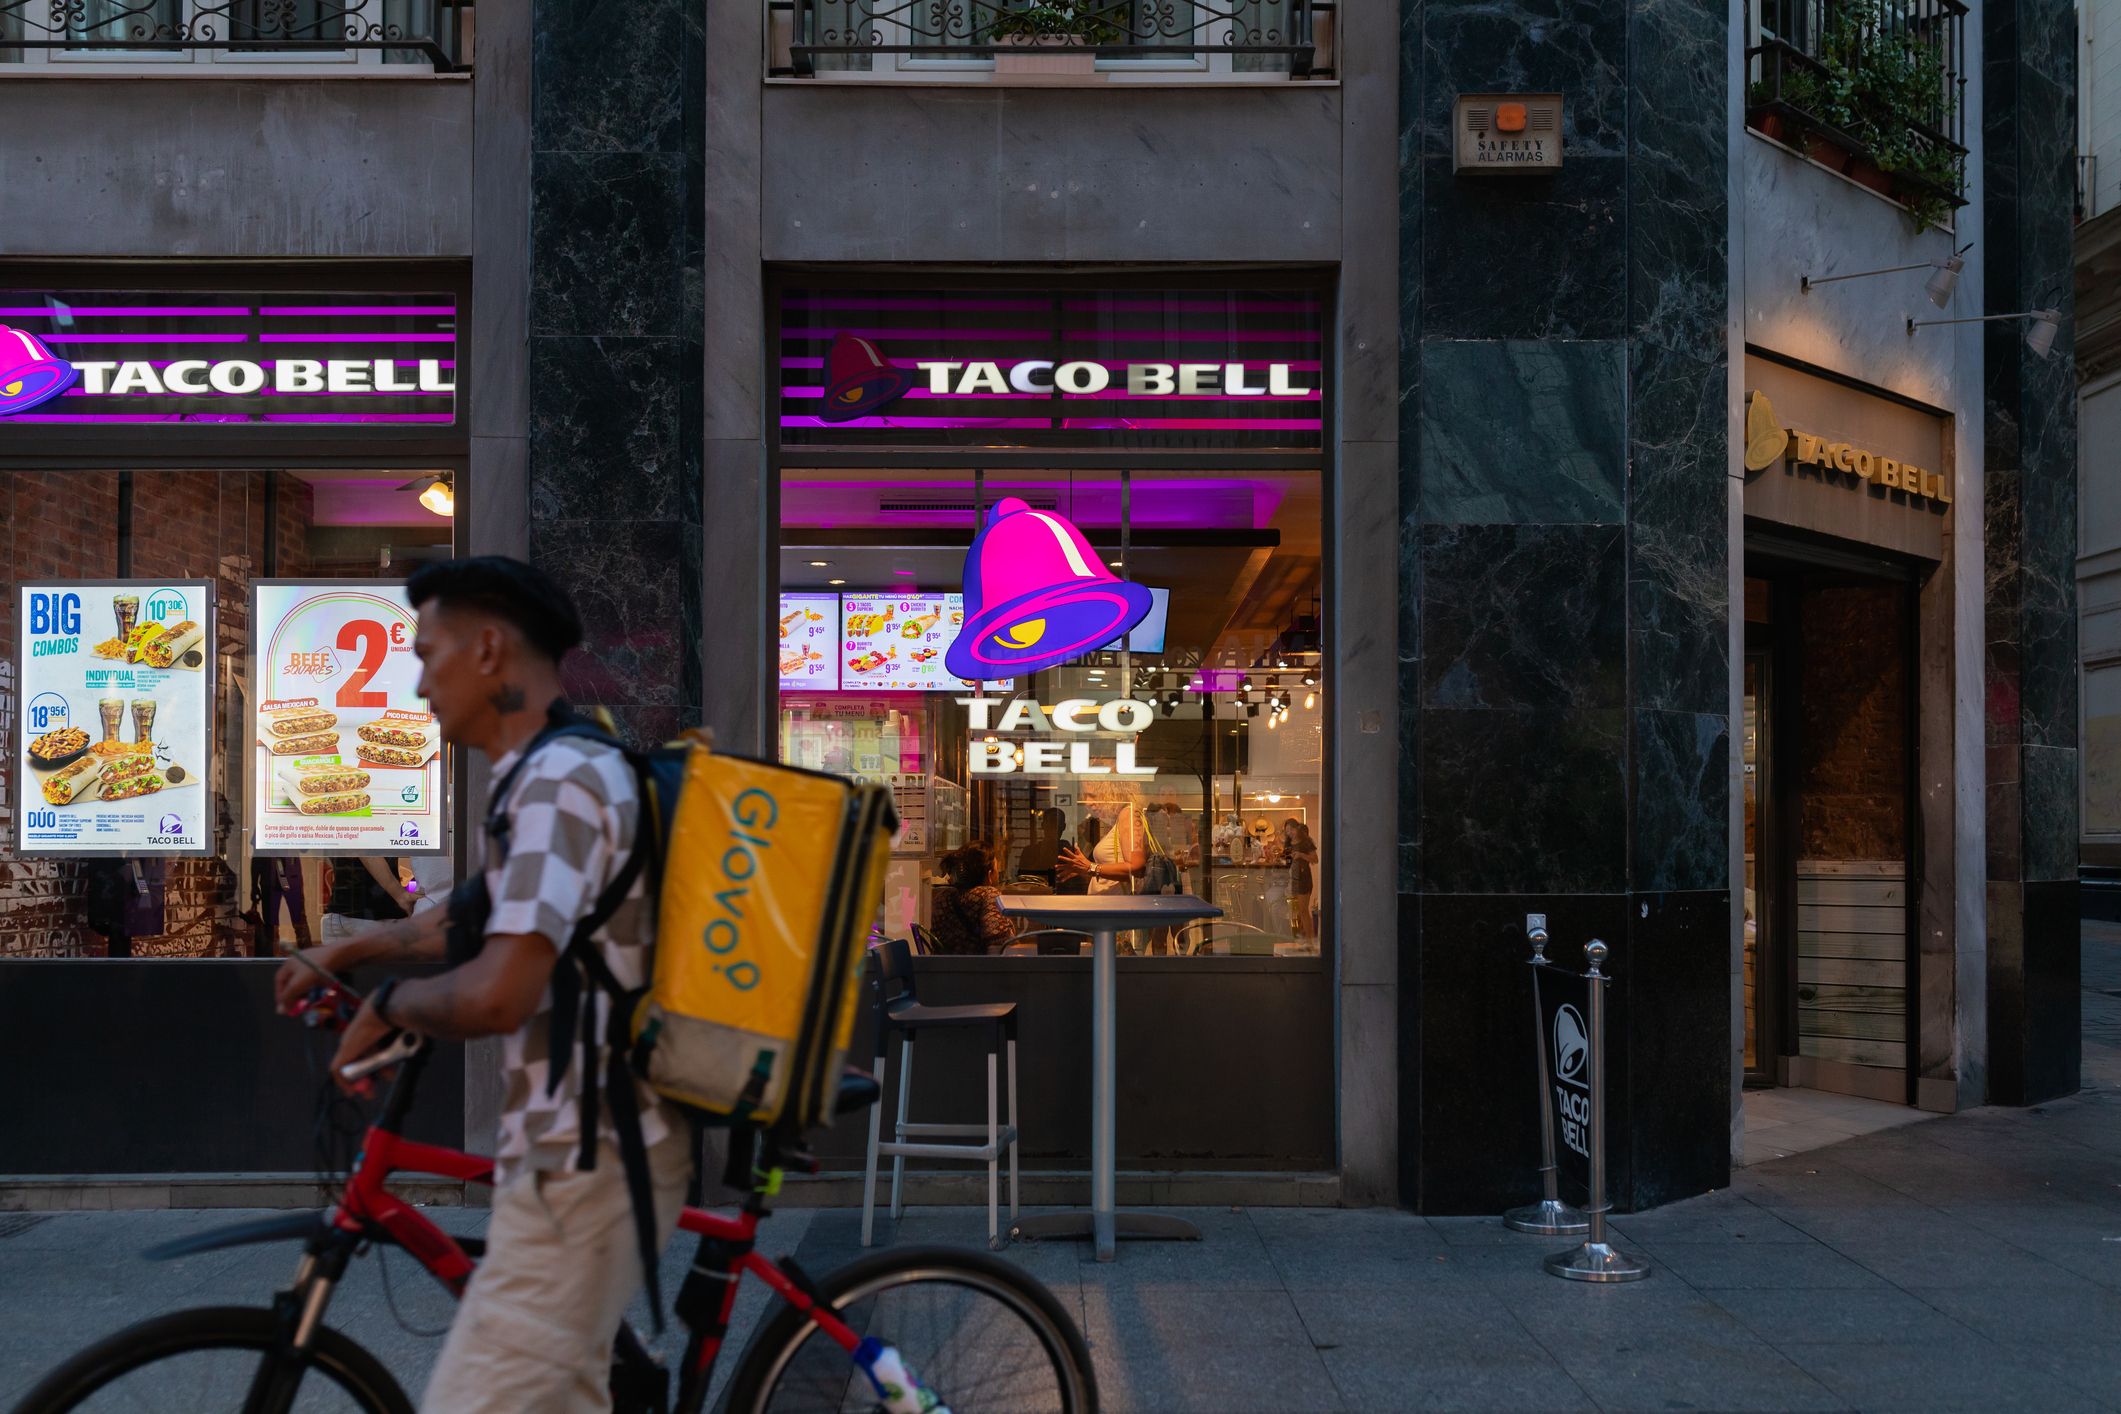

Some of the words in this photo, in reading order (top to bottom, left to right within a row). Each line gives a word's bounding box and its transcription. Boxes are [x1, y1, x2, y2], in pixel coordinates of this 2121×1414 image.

[1478, 140, 1543, 151] SAFETY
[1478, 151, 1543, 162] ALARMAS
[71, 359, 267, 394] TACO
[275, 358, 455, 393] BELL
[916, 359, 1109, 394] TACO
[1127, 362, 1311, 396] BELL
[1791, 429, 1875, 479] TACO
[1880, 456, 1953, 504] BELL
[30, 592, 81, 635] BIG
[390, 622, 406, 644] €
[32, 637, 79, 657] COMBOS
[290, 653, 330, 666] BEEF
[336, 618, 388, 708] 2
[85, 670, 135, 681] INDIVIDUAL
[282, 665, 334, 676] SQUARES
[262, 703, 281, 711] SALSA
[281, 701, 308, 710] MEXICAN
[386, 711, 400, 719] PICO
[954, 697, 1154, 733] TACO
[968, 741, 1159, 775] BELL
[27, 807, 56, 828] DÚO
[147, 837, 171, 845] TACO
[173, 837, 196, 845] BELL
[1556, 1085, 1589, 1126] TACO
[1561, 1116, 1589, 1158] BELL
